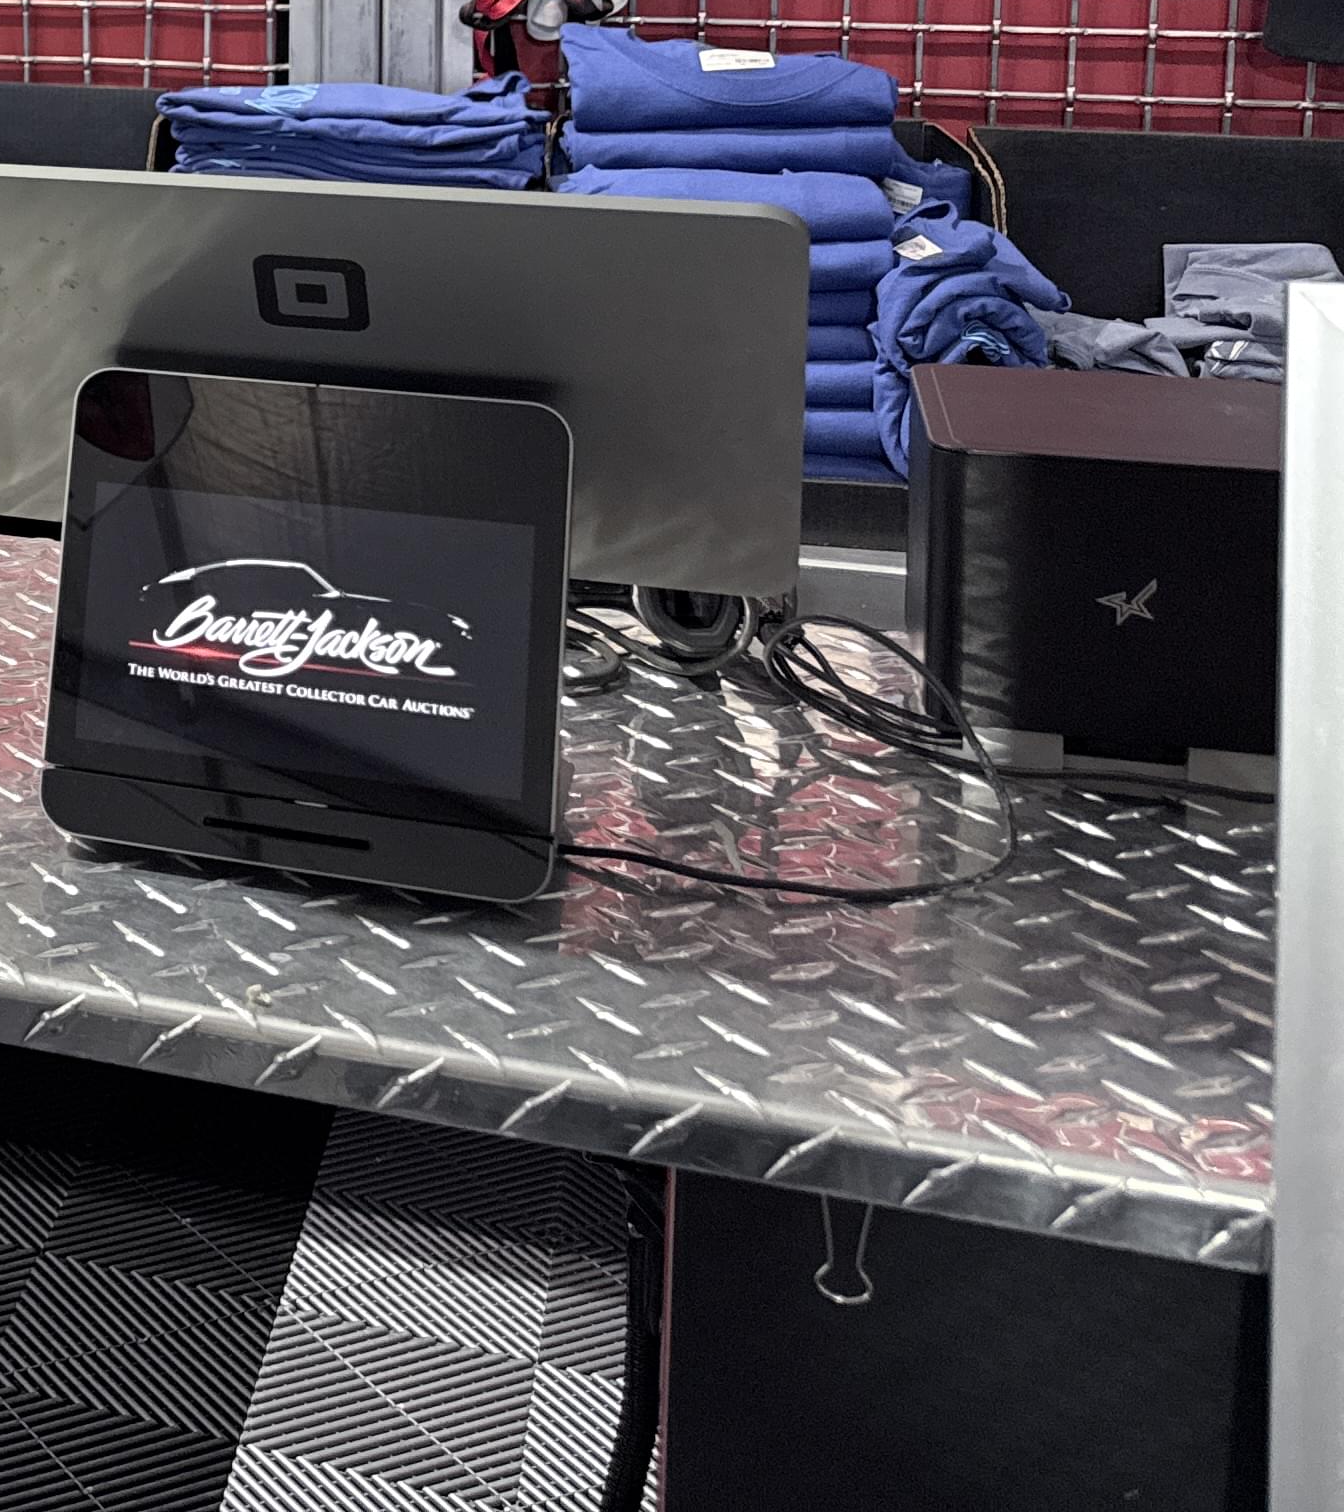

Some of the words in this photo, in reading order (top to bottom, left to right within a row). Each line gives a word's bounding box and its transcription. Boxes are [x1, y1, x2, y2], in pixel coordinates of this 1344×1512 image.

[152, 594, 457, 677] Barrett-Jackson
[127, 662, 155, 678] THE
[158, 667, 215, 686] WORLD'S
[218, 675, 284, 694] GREATEST
[286, 684, 365, 706] COLLECTOR
[368, 694, 398, 710] CAR
